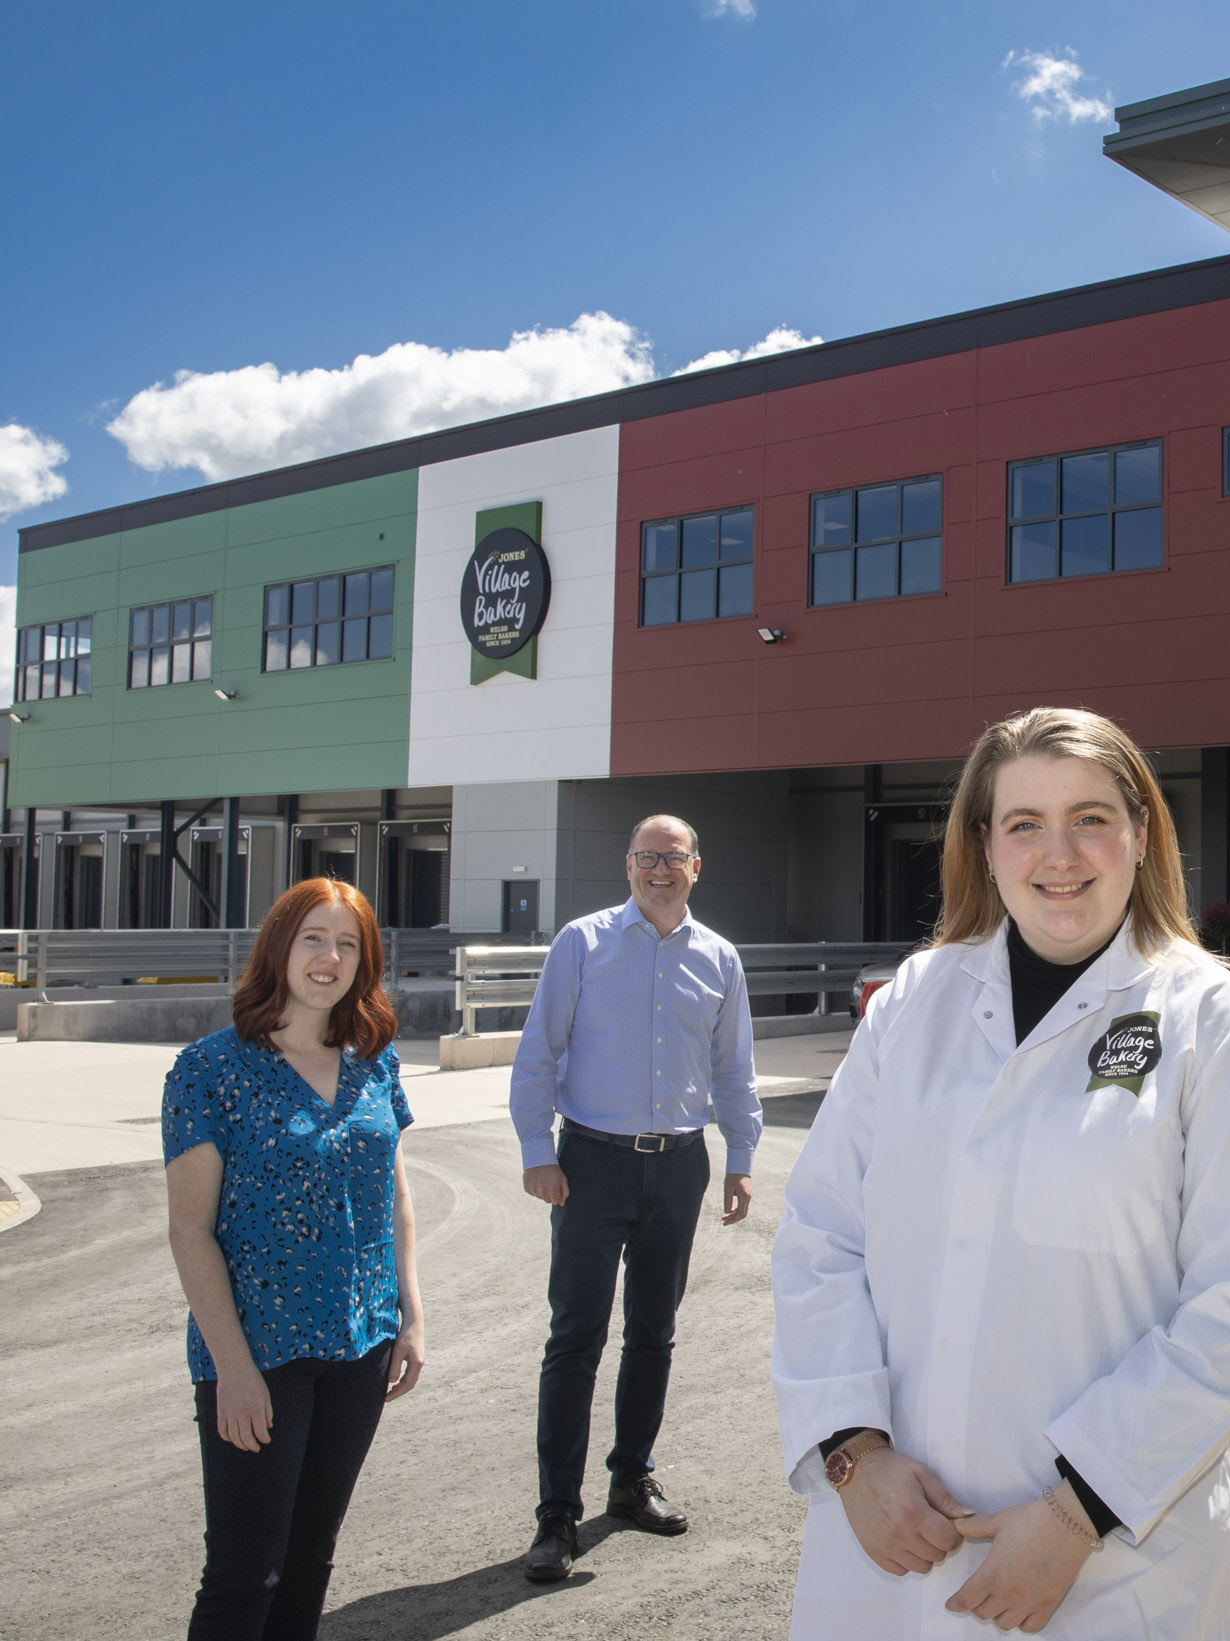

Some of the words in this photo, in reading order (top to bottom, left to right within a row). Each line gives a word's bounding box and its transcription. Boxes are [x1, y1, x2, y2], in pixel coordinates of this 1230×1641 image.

[474, 556, 530, 603] Village
[474, 596, 526, 629] Bakery
[478, 633, 497, 642] FAMILY
[498, 631, 519, 640] BAKERS
[1106, 1030, 1154, 1053] Village
[1097, 1050, 1148, 1070] Bakery
